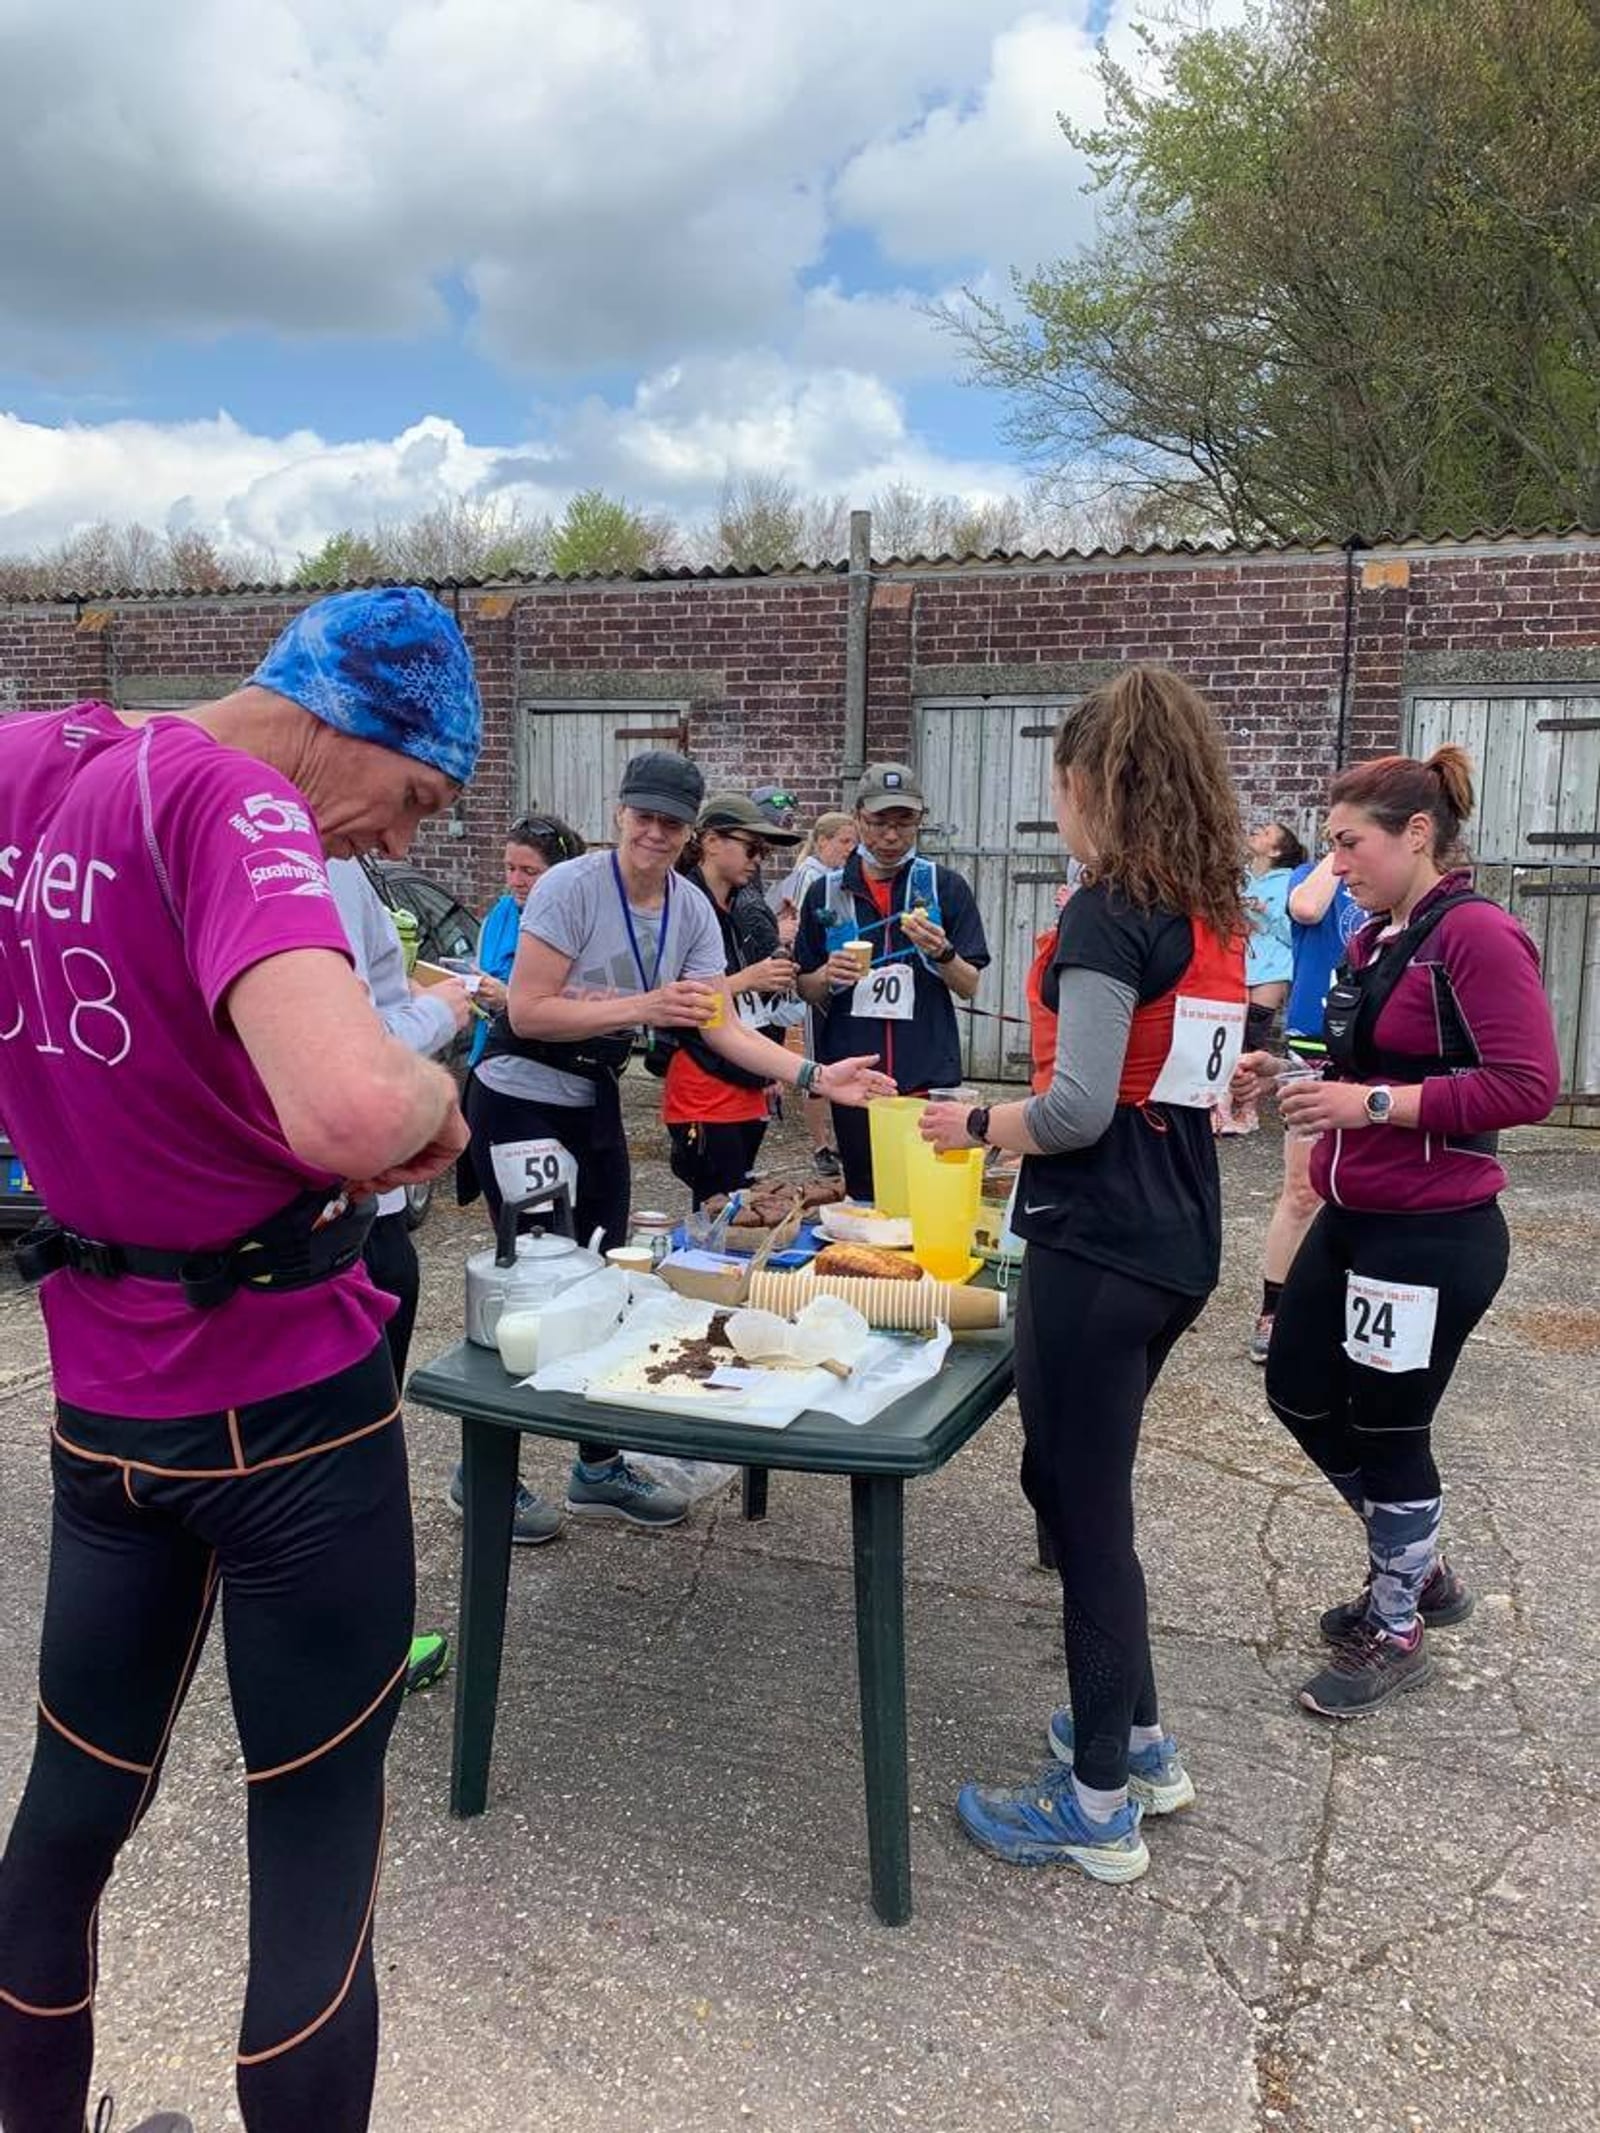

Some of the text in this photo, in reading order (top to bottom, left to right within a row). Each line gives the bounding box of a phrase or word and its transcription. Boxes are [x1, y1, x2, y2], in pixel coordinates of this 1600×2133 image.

[873, 975, 901, 1004] 90
[1206, 1026, 1227, 1081] 8
[525, 1155, 560, 1193] 59
[1352, 1297, 1396, 1348] 24
